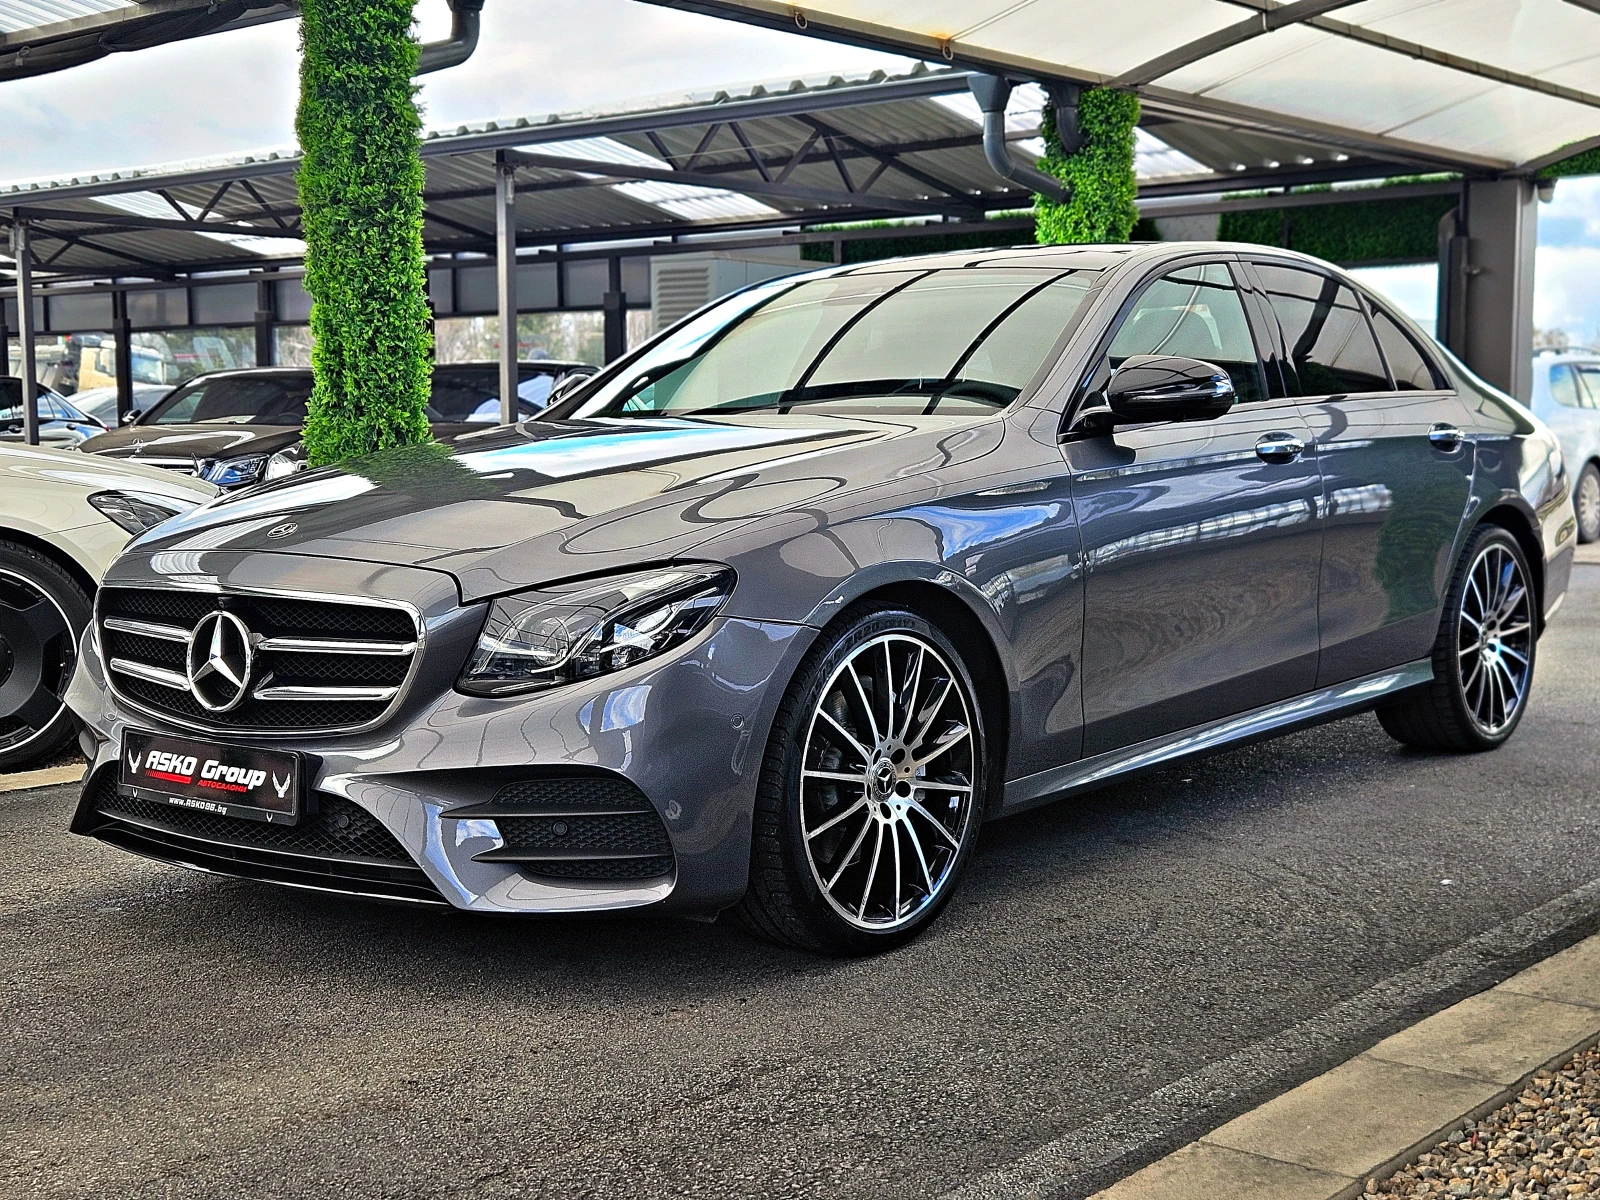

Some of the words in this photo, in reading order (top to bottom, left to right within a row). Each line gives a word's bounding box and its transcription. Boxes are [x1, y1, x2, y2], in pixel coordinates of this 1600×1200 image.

[146, 750, 197, 776] ASKO
[201, 760, 266, 789] Group
[197, 780, 247, 792] АВТОСАЛОНИ
